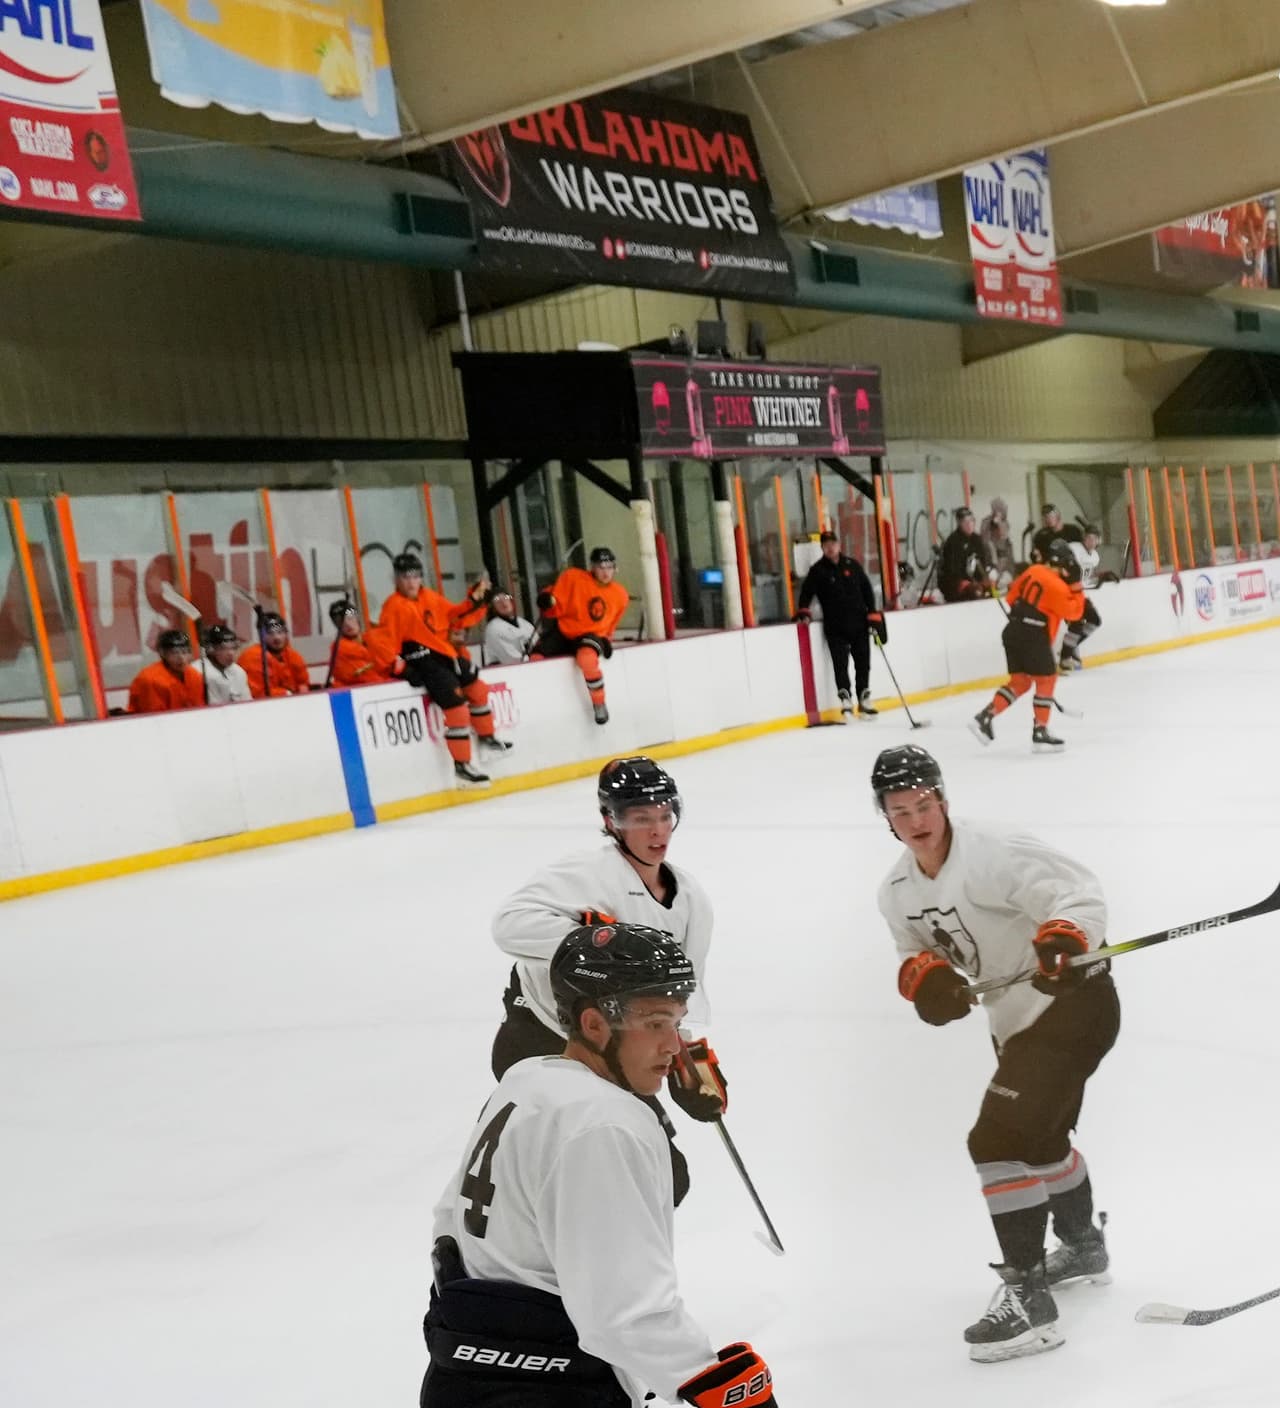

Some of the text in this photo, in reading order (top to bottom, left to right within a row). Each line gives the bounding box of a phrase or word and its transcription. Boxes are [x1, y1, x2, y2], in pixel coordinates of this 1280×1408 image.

[508, 102, 757, 181] OKLAHOMA
[540, 157, 759, 235] WARRIORS
[965, 175, 1009, 228] NAHL
[1011, 187, 1049, 237] NAHL
[710, 371, 820, 391] TAKE YOUR SHOT
[713, 395, 822, 427] PINK WHITNEY
[384, 706, 424, 747] 800
[1167, 913, 1231, 942] BAUER
[573, 967, 609, 981] BAUER
[460, 1096, 518, 1239] 4
[452, 1344, 572, 1373] BAUER
